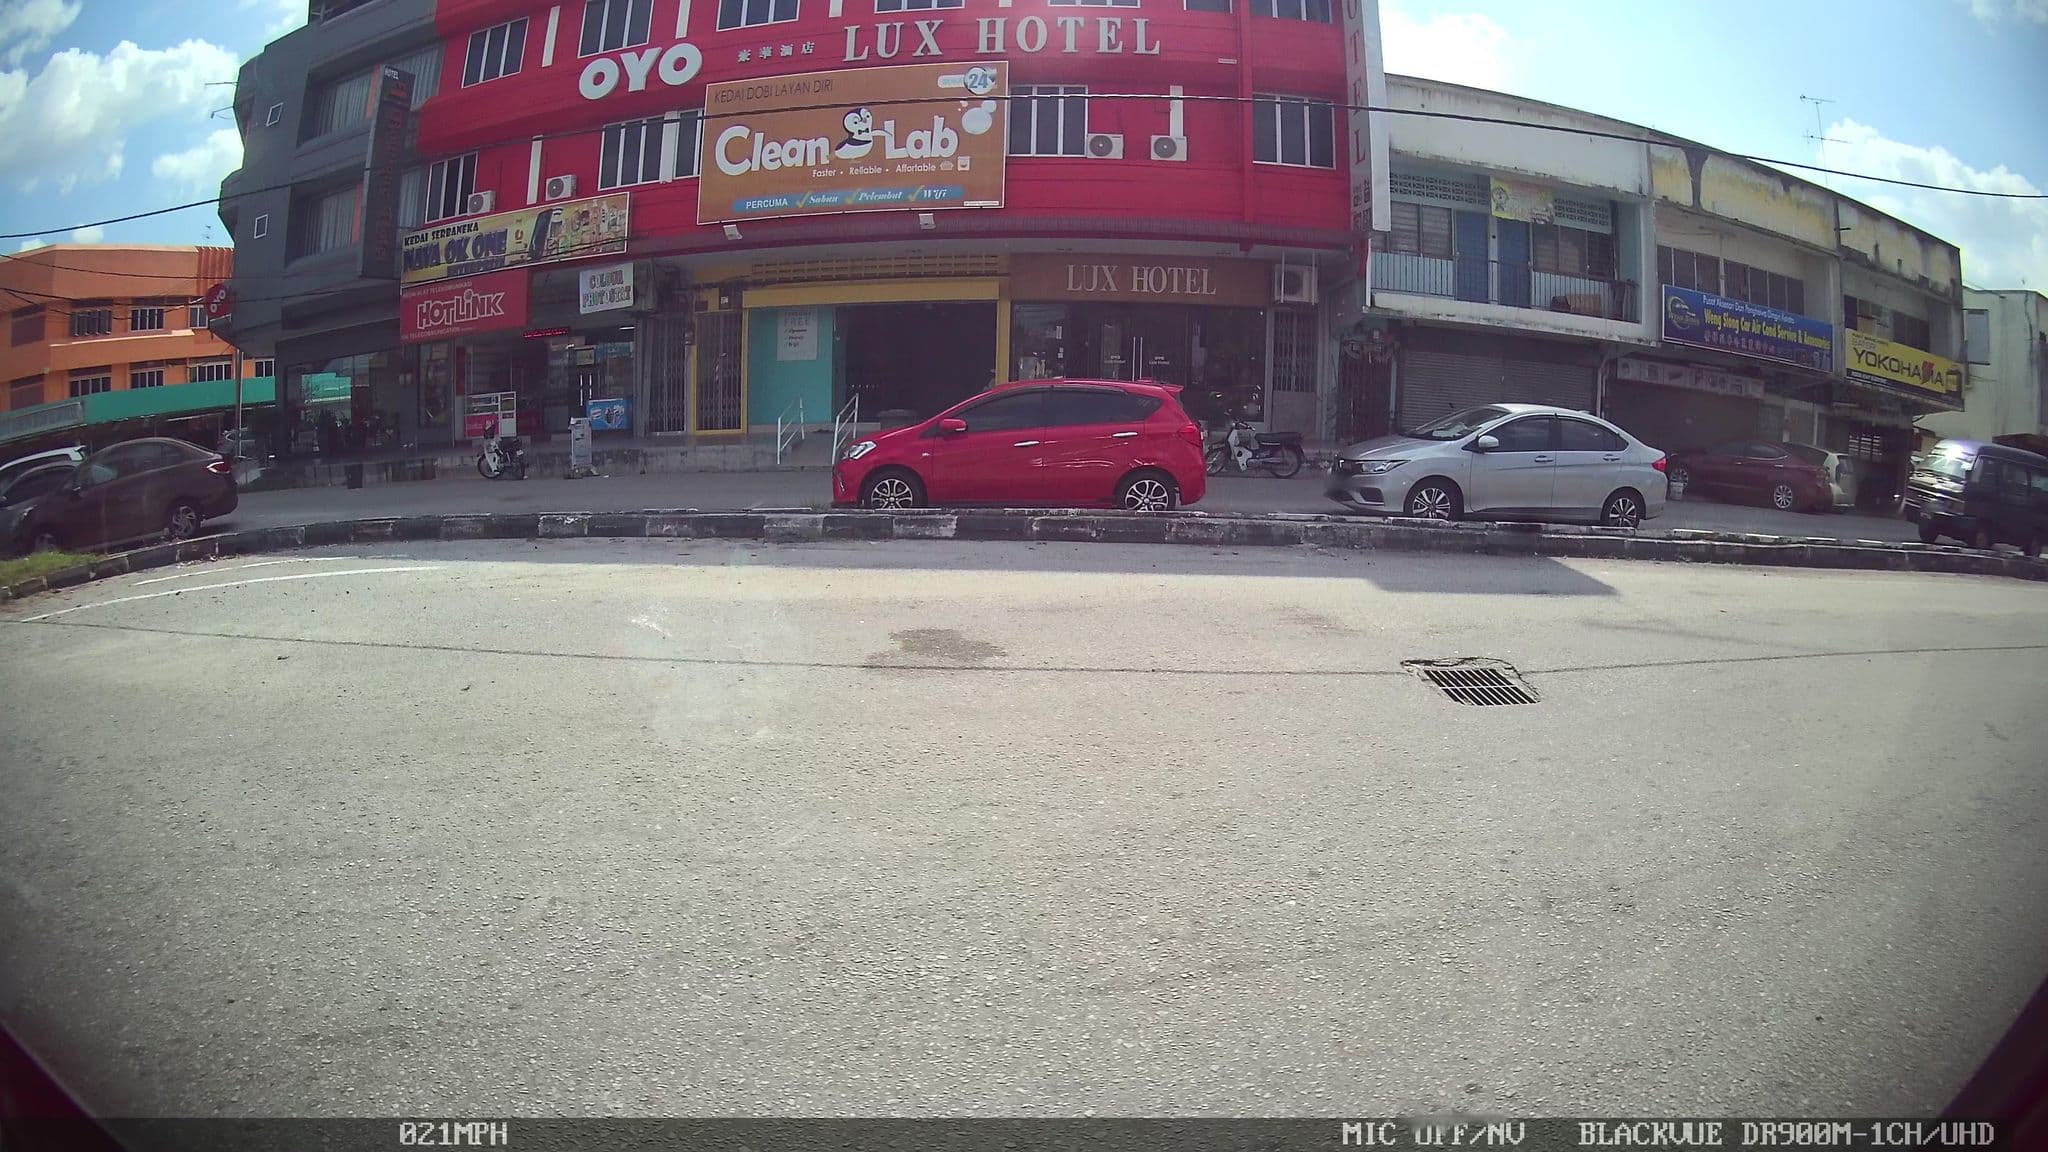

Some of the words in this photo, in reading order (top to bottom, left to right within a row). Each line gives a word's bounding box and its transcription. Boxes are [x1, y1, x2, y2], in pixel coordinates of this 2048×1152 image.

[843, 20, 944, 62] LUX
[976, 16, 1161, 55] HOTEL
[579, 43, 702, 100] OYO
[968, 73, 988, 89] 24
[714, 86, 744, 103] KEDAI
[746, 84, 773, 101] DOBI
[775, 80, 810, 98] LAYAN
[814, 79, 833, 93] DIRI
[715, 125, 829, 176] Clean
[884, 116, 960, 160] Lab
[812, 168, 836, 179] Faster
[849, 165, 882, 176] Reliable
[745, 198, 788, 209] PERCUMA
[808, 194, 838, 205] Sabun
[859, 190, 902, 201] Pelembut
[404, 233, 428, 247] KEDAI
[432, 222, 479, 240] SERBANEKA
[1066, 264, 1118, 292] LUX
[1131, 265, 1217, 295] HOTEL
[1704, 308, 1722, 330] Weng
